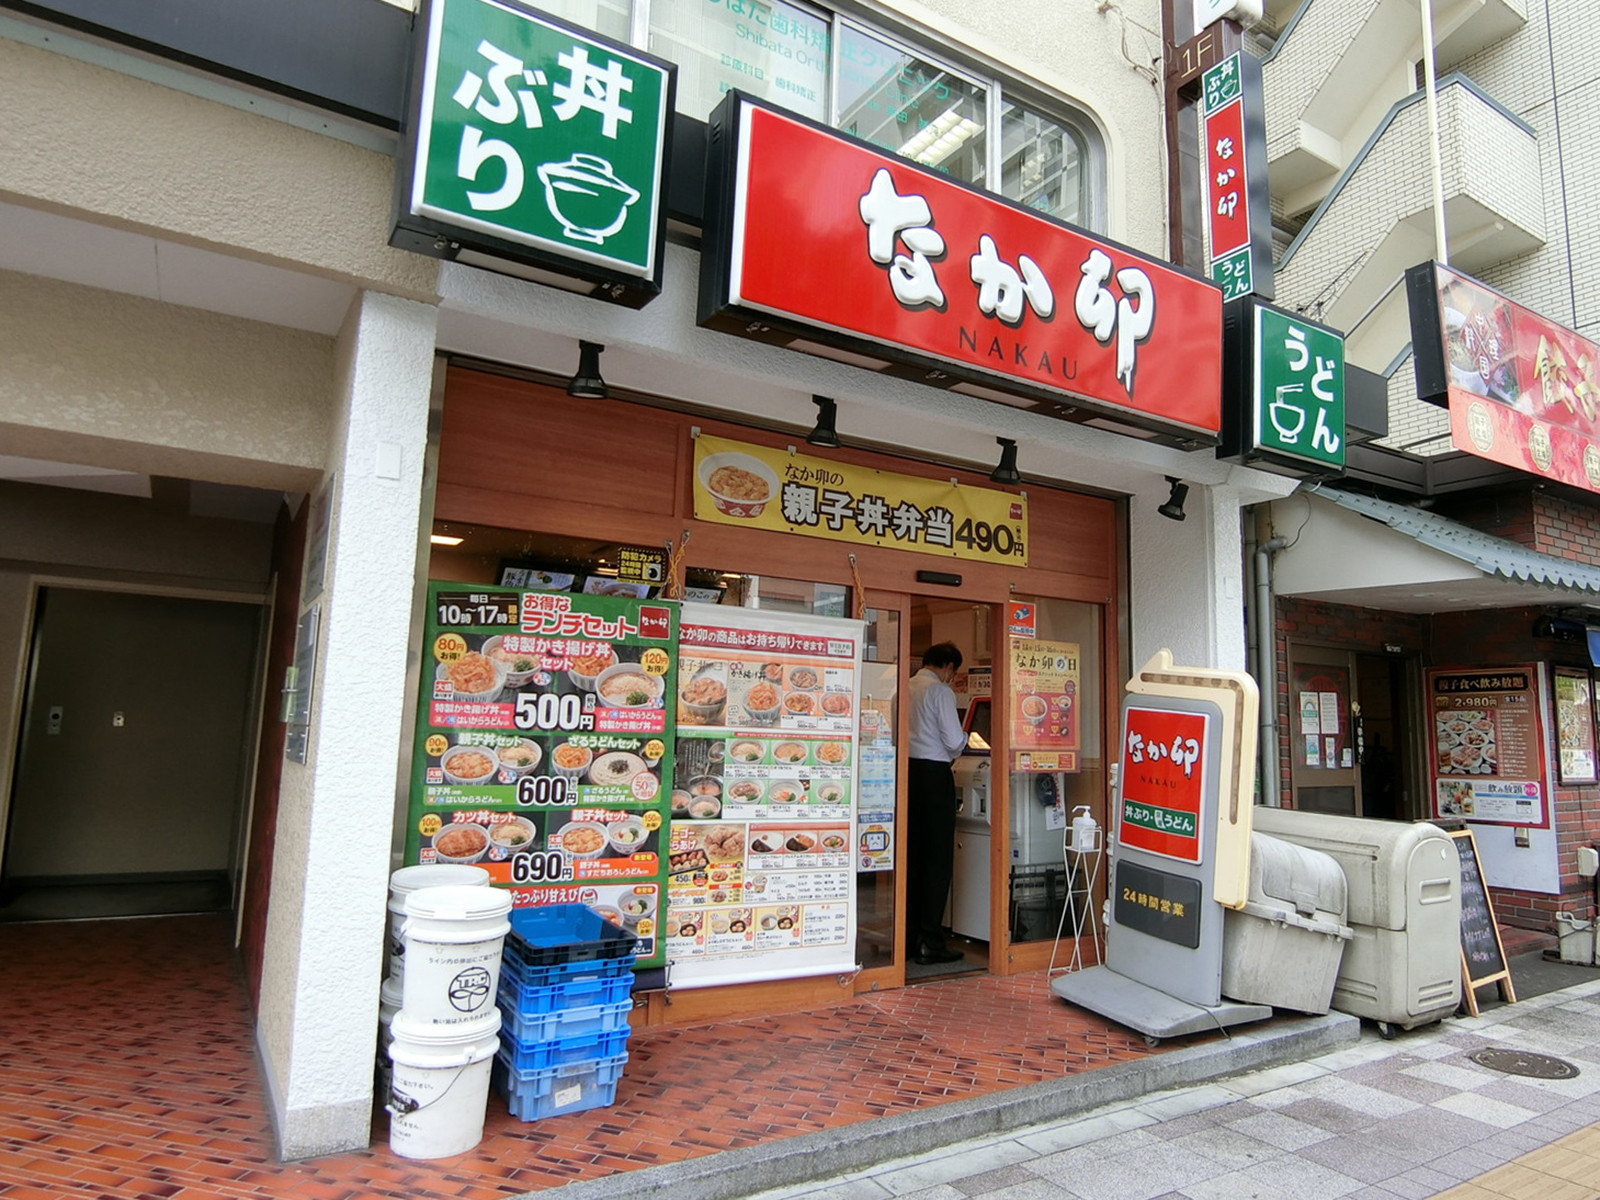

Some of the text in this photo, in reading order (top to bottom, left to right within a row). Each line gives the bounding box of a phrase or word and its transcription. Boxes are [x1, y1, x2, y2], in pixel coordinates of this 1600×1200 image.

[735, 22, 793, 59] Shibata
[1181, 33, 1213, 78] 1F
[1216, 137, 1239, 219] なか卯
[859, 168, 1155, 393] なか卯
[959, 326, 1078, 380] NAKAU
[1284, 325, 1340, 454] うどん
[784, 462, 844, 487] なか卯の
[781, 480, 954, 549] 親子丼弁当
[620, 550, 662, 563] 防犯カメラ
[470, 594, 488, 603] 毎日
[523, 593, 571, 612] お得な
[522, 610, 637, 640] ランチセット
[503, 635, 612, 658] 特製かき揚げ丼
[540, 656, 574, 672] セット
[1015, 653, 1077, 671] なか卯の日
[514, 693, 594, 730] 500円
[568, 735, 641, 749] ざるうどんセット
[1127, 730, 1200, 780] なか卯
[518, 777, 578, 804] 600円
[1140, 775, 1178, 789] NAKAU
[452, 810, 517, 824] カツ丼セット
[512, 853, 573, 881] 690円
[1123, 887, 1185, 918] 24時間営業
